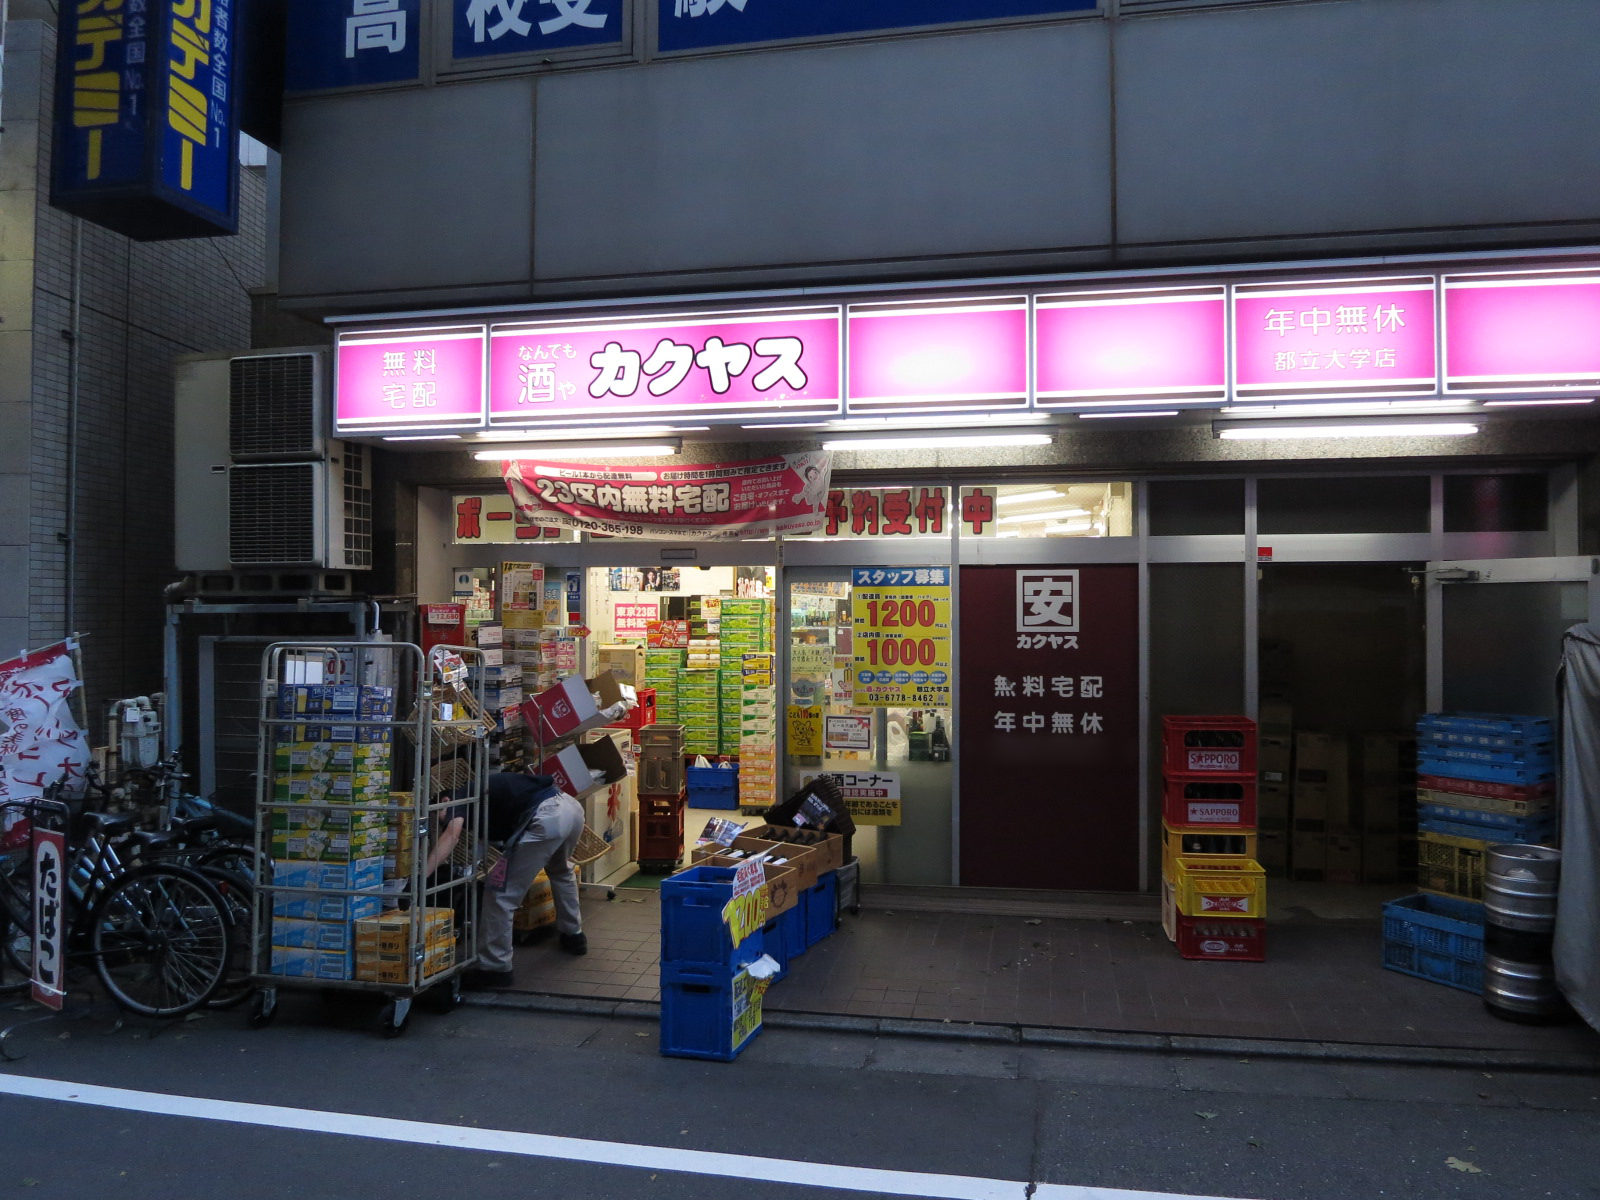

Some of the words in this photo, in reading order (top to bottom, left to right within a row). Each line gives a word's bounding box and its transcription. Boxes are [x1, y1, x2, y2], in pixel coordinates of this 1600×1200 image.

[1264, 304, 1406, 338] 年中無休
[382, 347, 437, 377] 無料
[518, 343, 577, 361] なんでも
[1274, 347, 1397, 374] 都立大学店
[588, 335, 808, 399] カクヤス
[382, 383, 437, 409] 宅配
[535, 478, 730, 516] 23区内無料宅配
[572, 521, 643, 535] 0120-365-198
[858, 569, 944, 585] スタッフ募集
[867, 600, 936, 628] 1200
[867, 638, 936, 666] 1000
[1017, 634, 1079, 650] カクヤス
[869, 694, 934, 702] 03-6778-8462
[994, 675, 1104, 698] 無料宅配
[994, 712, 1104, 734] 年中無休
[845, 801, 898, 809] 年齢であることを
[848, 809, 893, 817] 合には酒類を
[1199, 808, 1238, 817] SAPPORO
[38, 852, 58, 985] たばこ
